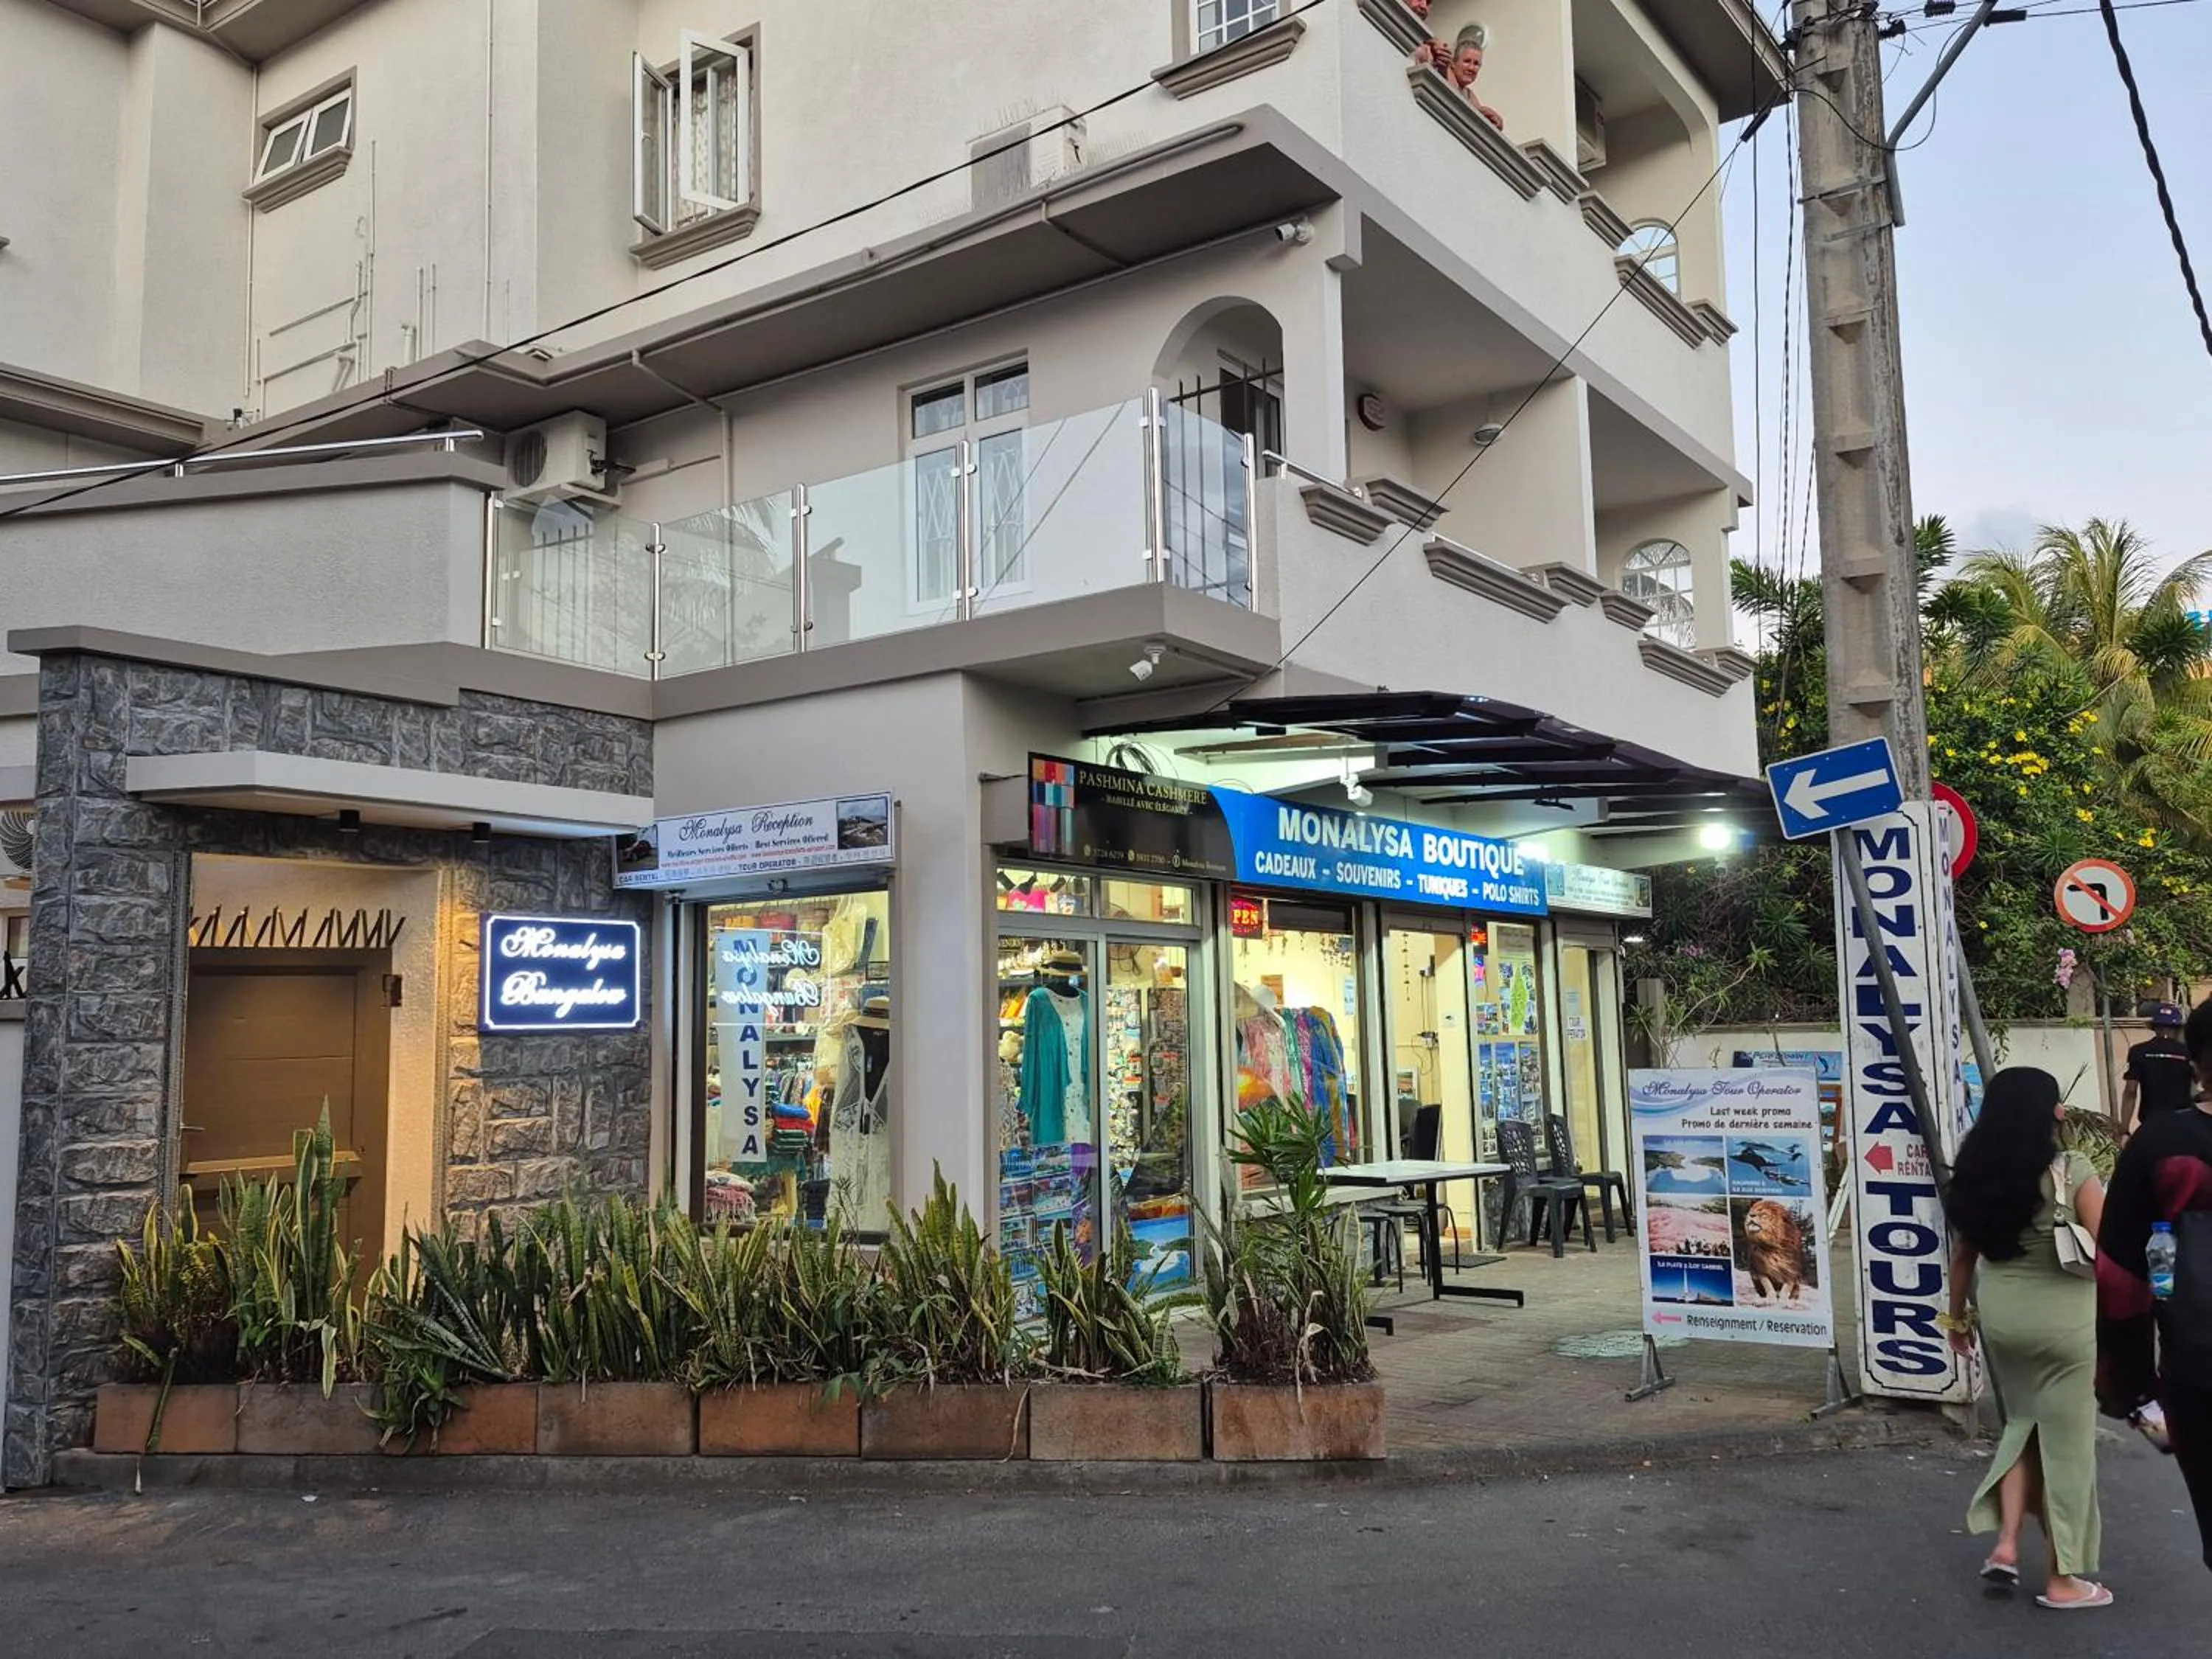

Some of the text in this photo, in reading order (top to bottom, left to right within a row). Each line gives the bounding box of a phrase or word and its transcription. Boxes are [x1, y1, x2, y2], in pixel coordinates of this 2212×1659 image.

[1079, 770, 1208, 804] PASHMINA CASHMERE
[679, 810, 814, 844] Monalysa Reception
[1278, 807, 1524, 879] MONALYSA BOUTIQUE
[759, 858, 796, 869] OPERATOR
[1255, 850, 1316, 880] CADEAUX
[1336, 861, 1402, 890] SOUVENIRS
[1417, 874, 1468, 900] TUNIQUES
[1483, 881, 1507, 902] POLO
[1509, 886, 1540, 906] SHIRTS
[1232, 908, 1259, 925] PEN
[501, 926, 626, 970] Monalysa
[1938, 816, 1963, 1085] MONALYSA
[1852, 827, 1921, 1134] MONALYSA
[733, 938, 759, 1155] MONALYSA
[1642, 1080, 1802, 1101] Monalysa Tour Operator
[1682, 1118, 1813, 1129] Promo de dernière semaine
[1710, 1106, 1791, 1117] Last week promo
[1897, 1161, 1933, 1177] RENTA
[1865, 1180, 1947, 1375] TOURS
[1686, 1315, 1757, 1332] Renseignment
[1767, 1320, 1827, 1336] Reservation
